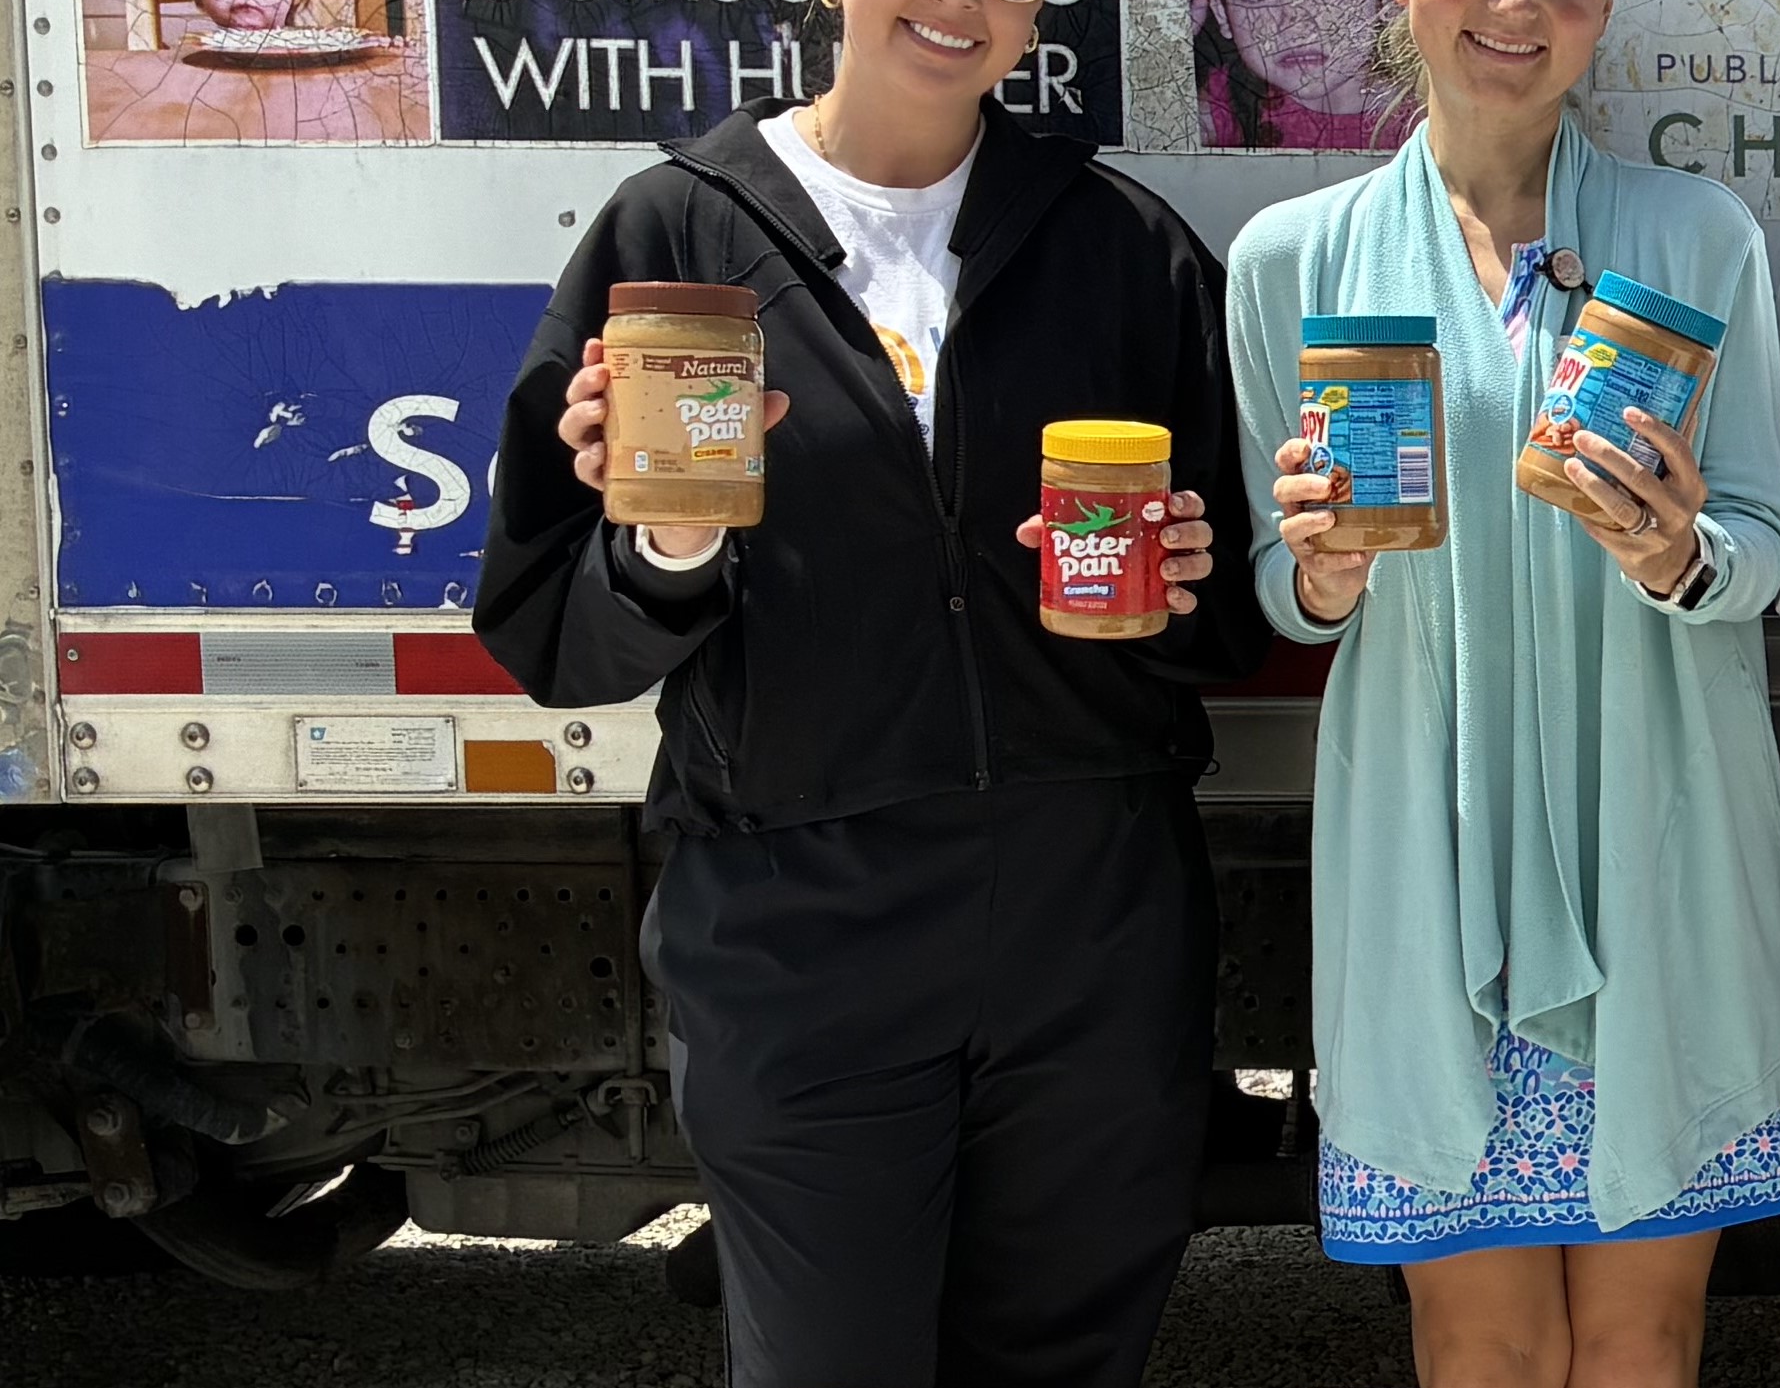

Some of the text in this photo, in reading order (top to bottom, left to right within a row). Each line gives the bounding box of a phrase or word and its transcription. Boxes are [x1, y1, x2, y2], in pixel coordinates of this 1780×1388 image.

[473, 36, 695, 112] WITH
[681, 360, 747, 377] Natural
[675, 398, 752, 424] Peter
[686, 421, 746, 448] Pan
[1050, 530, 1135, 558] Peter
[1057, 556, 1124, 583] Pan
